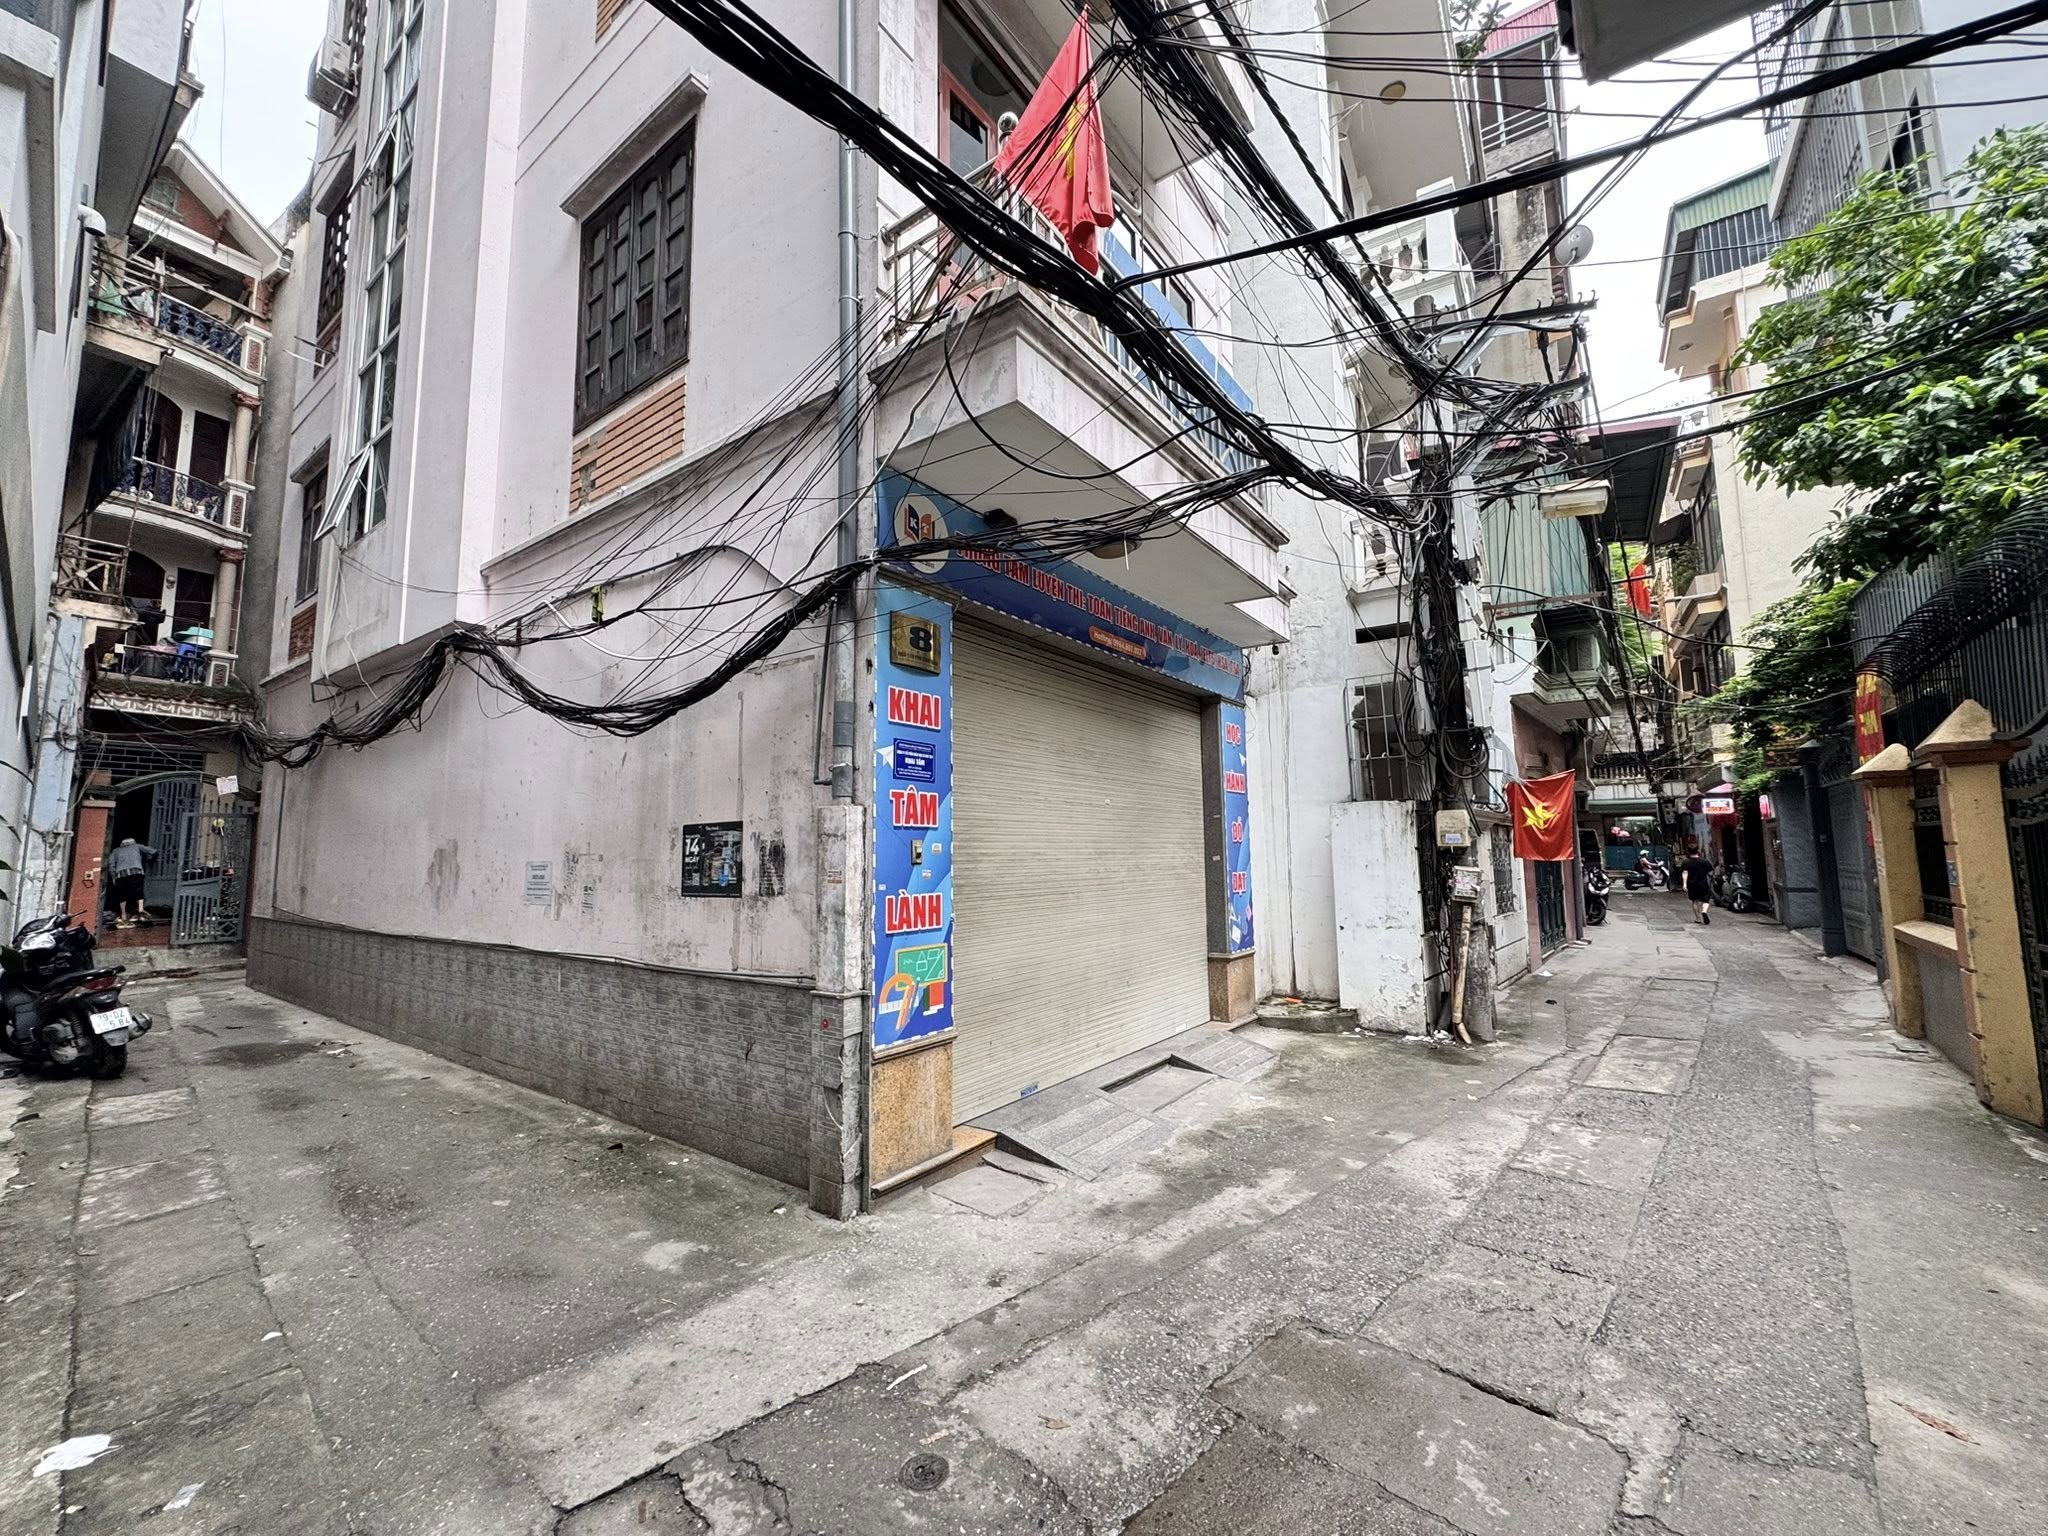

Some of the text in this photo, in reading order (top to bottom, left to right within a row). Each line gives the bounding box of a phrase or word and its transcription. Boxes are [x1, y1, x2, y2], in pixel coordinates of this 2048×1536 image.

[1003, 554, 1030, 586] TÂM
[1031, 566, 1065, 602] LUYỆN
[1066, 582, 1087, 611] THI:
[909, 626, 932, 653] 8
[889, 685, 941, 732] KHAI
[1225, 721, 1242, 747] HỌC
[1225, 768, 1246, 794] HÀNH
[889, 785, 939, 828] TÂM
[685, 837, 700, 855] 14
[886, 889, 943, 935] LÀNH
